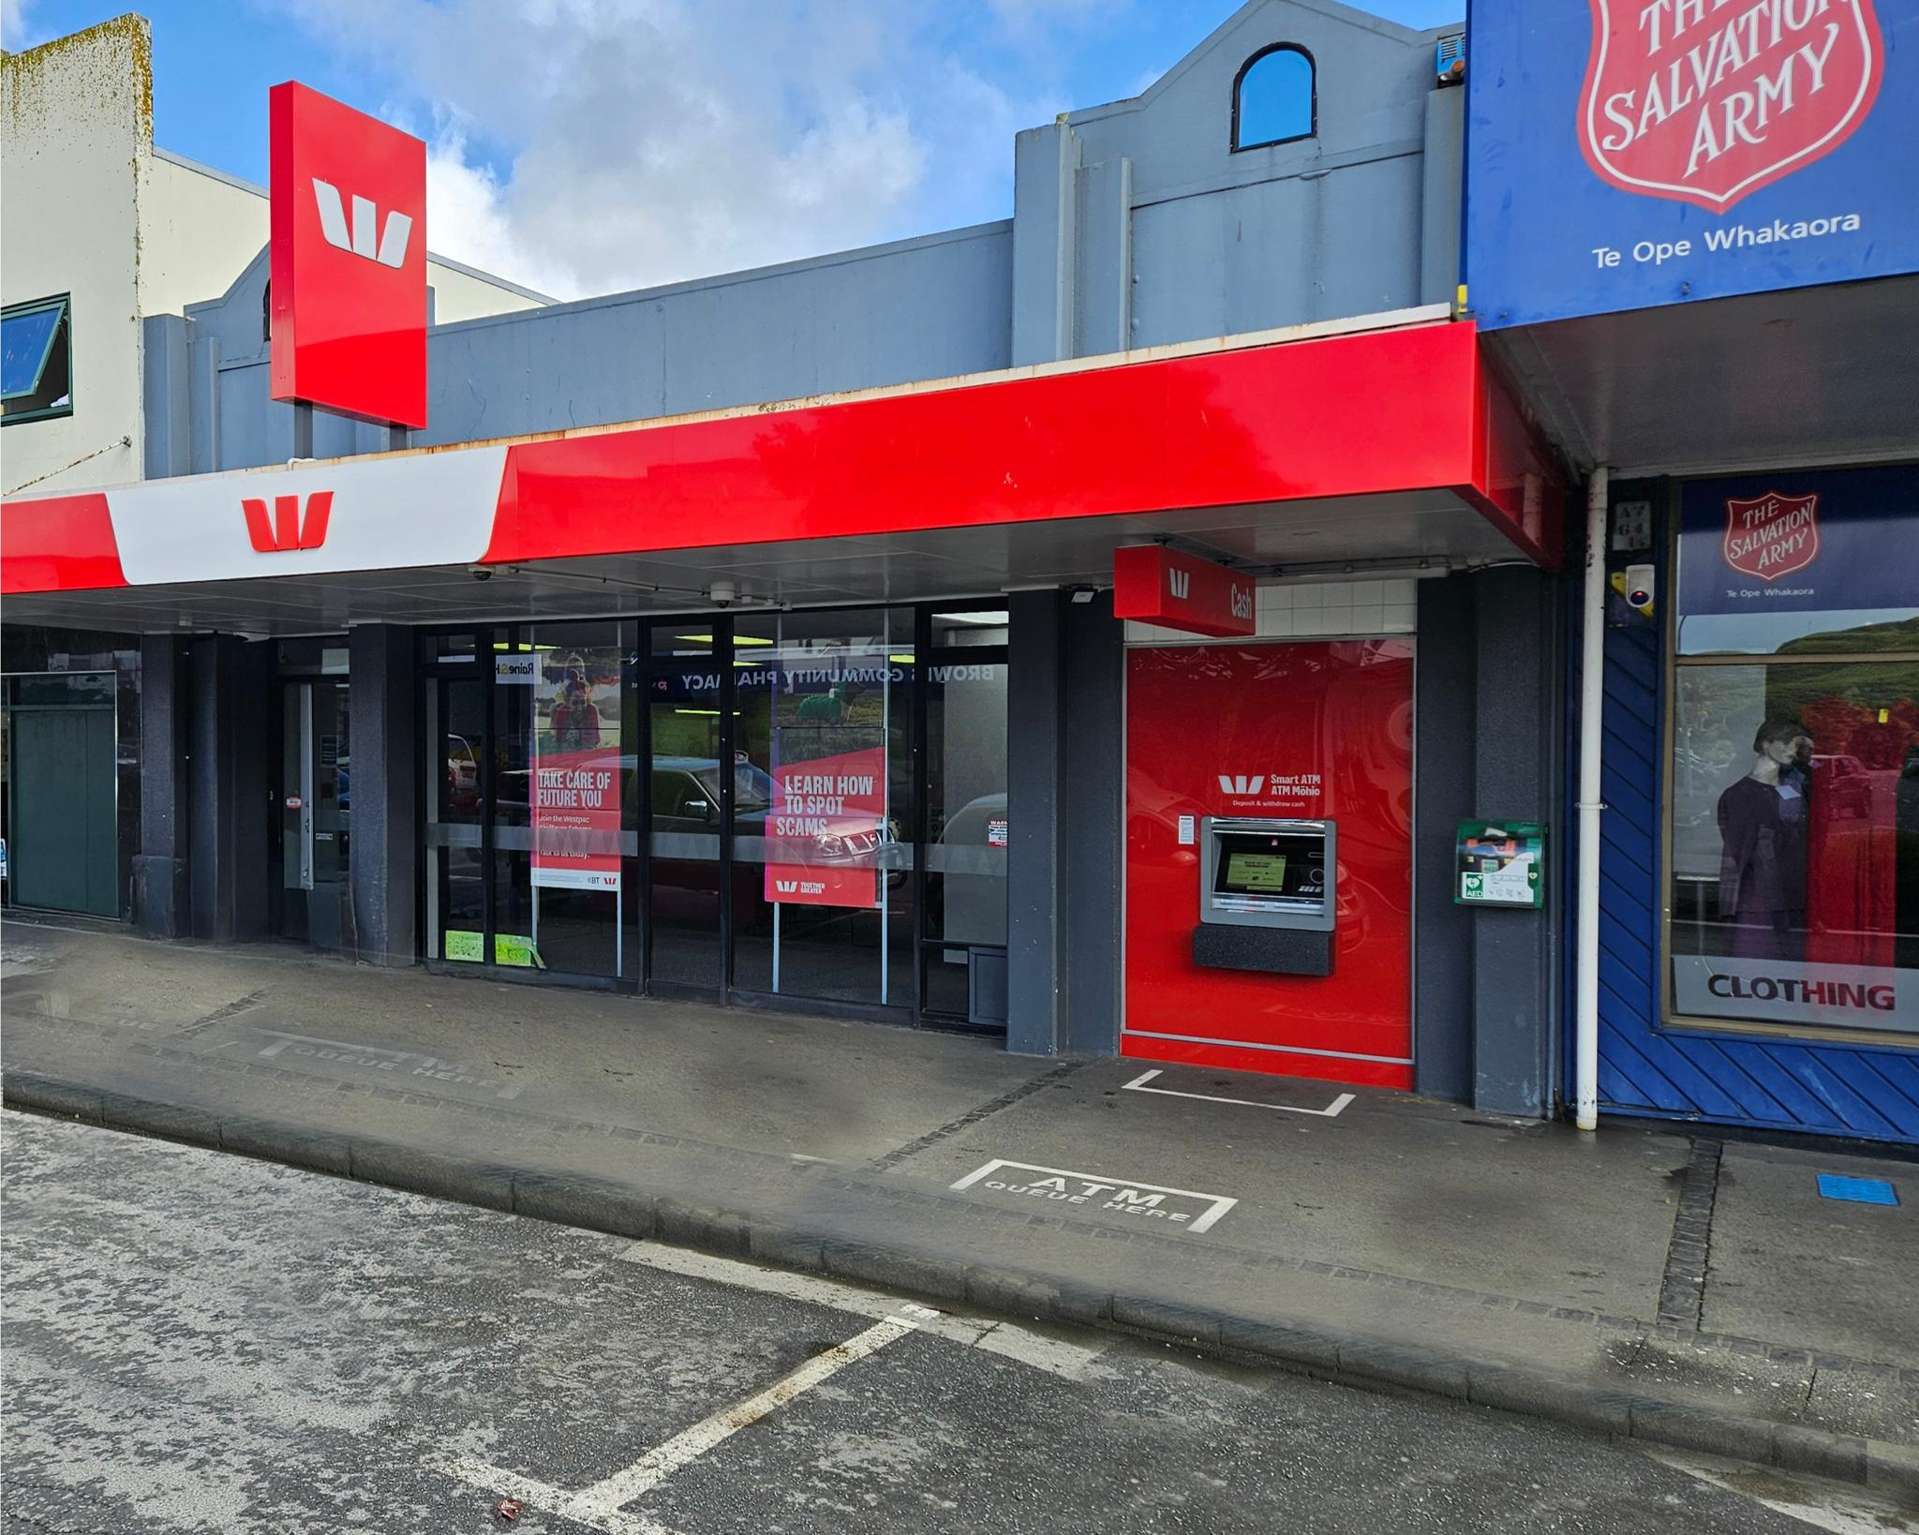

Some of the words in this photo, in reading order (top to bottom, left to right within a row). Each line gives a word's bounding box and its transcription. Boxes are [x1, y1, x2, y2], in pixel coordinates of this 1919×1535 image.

[1639, 0, 1731, 57] TH
[1682, 22, 1839, 179] ARMY
[1592, 247, 1622, 269] Te
[1632, 239, 1691, 265] Ope
[1704, 213, 1860, 252] Whakaora
[1742, 499, 1780, 529] THE
[1729, 502, 1811, 560] SALVATION
[1758, 527, 1809, 570] ARMY
[1231, 583, 1252, 620] Cash
[1726, 590, 1737, 598] Te
[1740, 589, 1760, 598] Ope
[1764, 588, 1815, 597] Whakaora
[539, 771, 563, 788] TAKE
[567, 772, 594, 789] CARE
[597, 773, 612, 790] OF
[785, 775, 833, 795] LEARN
[837, 776, 874, 796] HOW
[1271, 774, 1299, 785] Smart
[1300, 774, 1321, 785] ATM
[1271, 785, 1290, 796] ATM
[538, 789, 578, 807] FUTURE
[581, 790, 602, 808] YOU
[785, 795, 803, 815] TO
[807, 796, 845, 816] SPOT
[1707, 974, 1896, 1011] CLOTHING
[984, 1181, 1091, 1205] QUEUE
[1102, 1201, 1192, 1223] HERE
[1028, 1177, 1167, 1208] ATM
